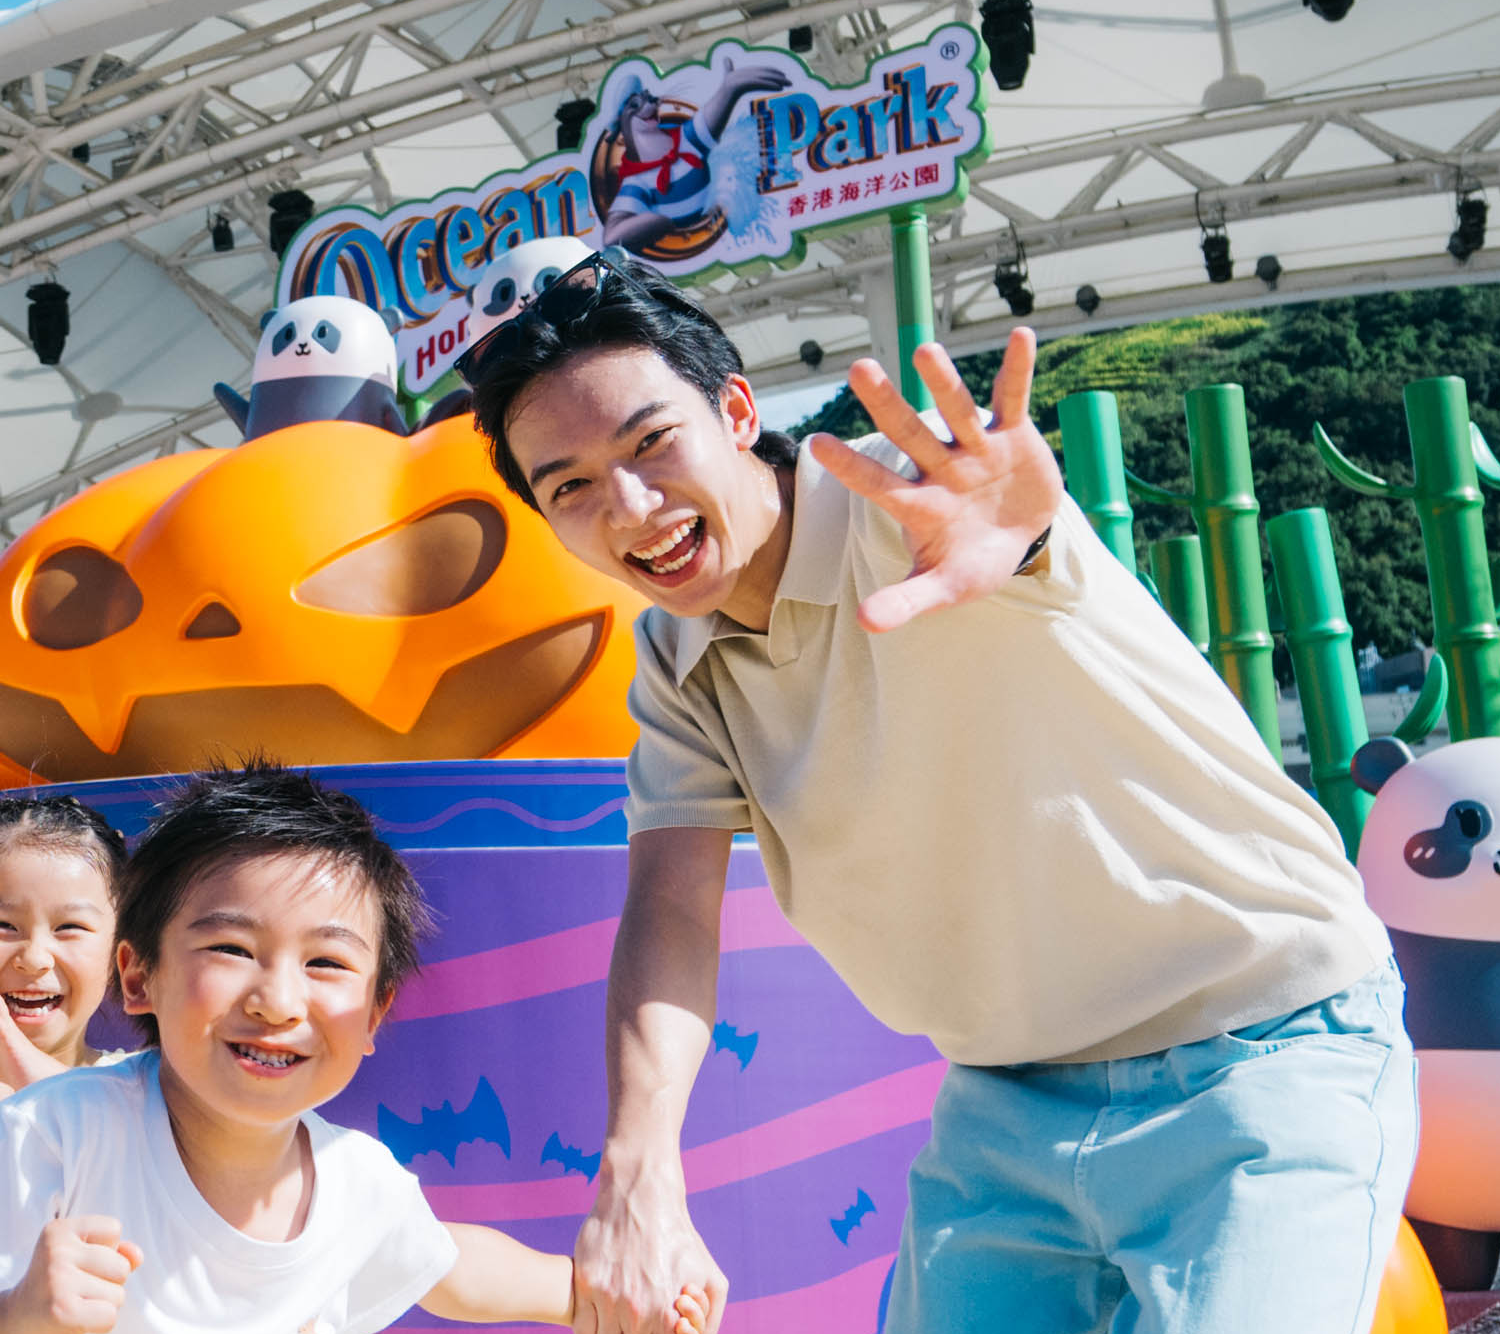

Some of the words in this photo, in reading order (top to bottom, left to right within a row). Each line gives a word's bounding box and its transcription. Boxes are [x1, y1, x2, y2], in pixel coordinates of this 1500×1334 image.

[752, 62, 964, 196] Park
[788, 163, 940, 216] 香港海洋公園
